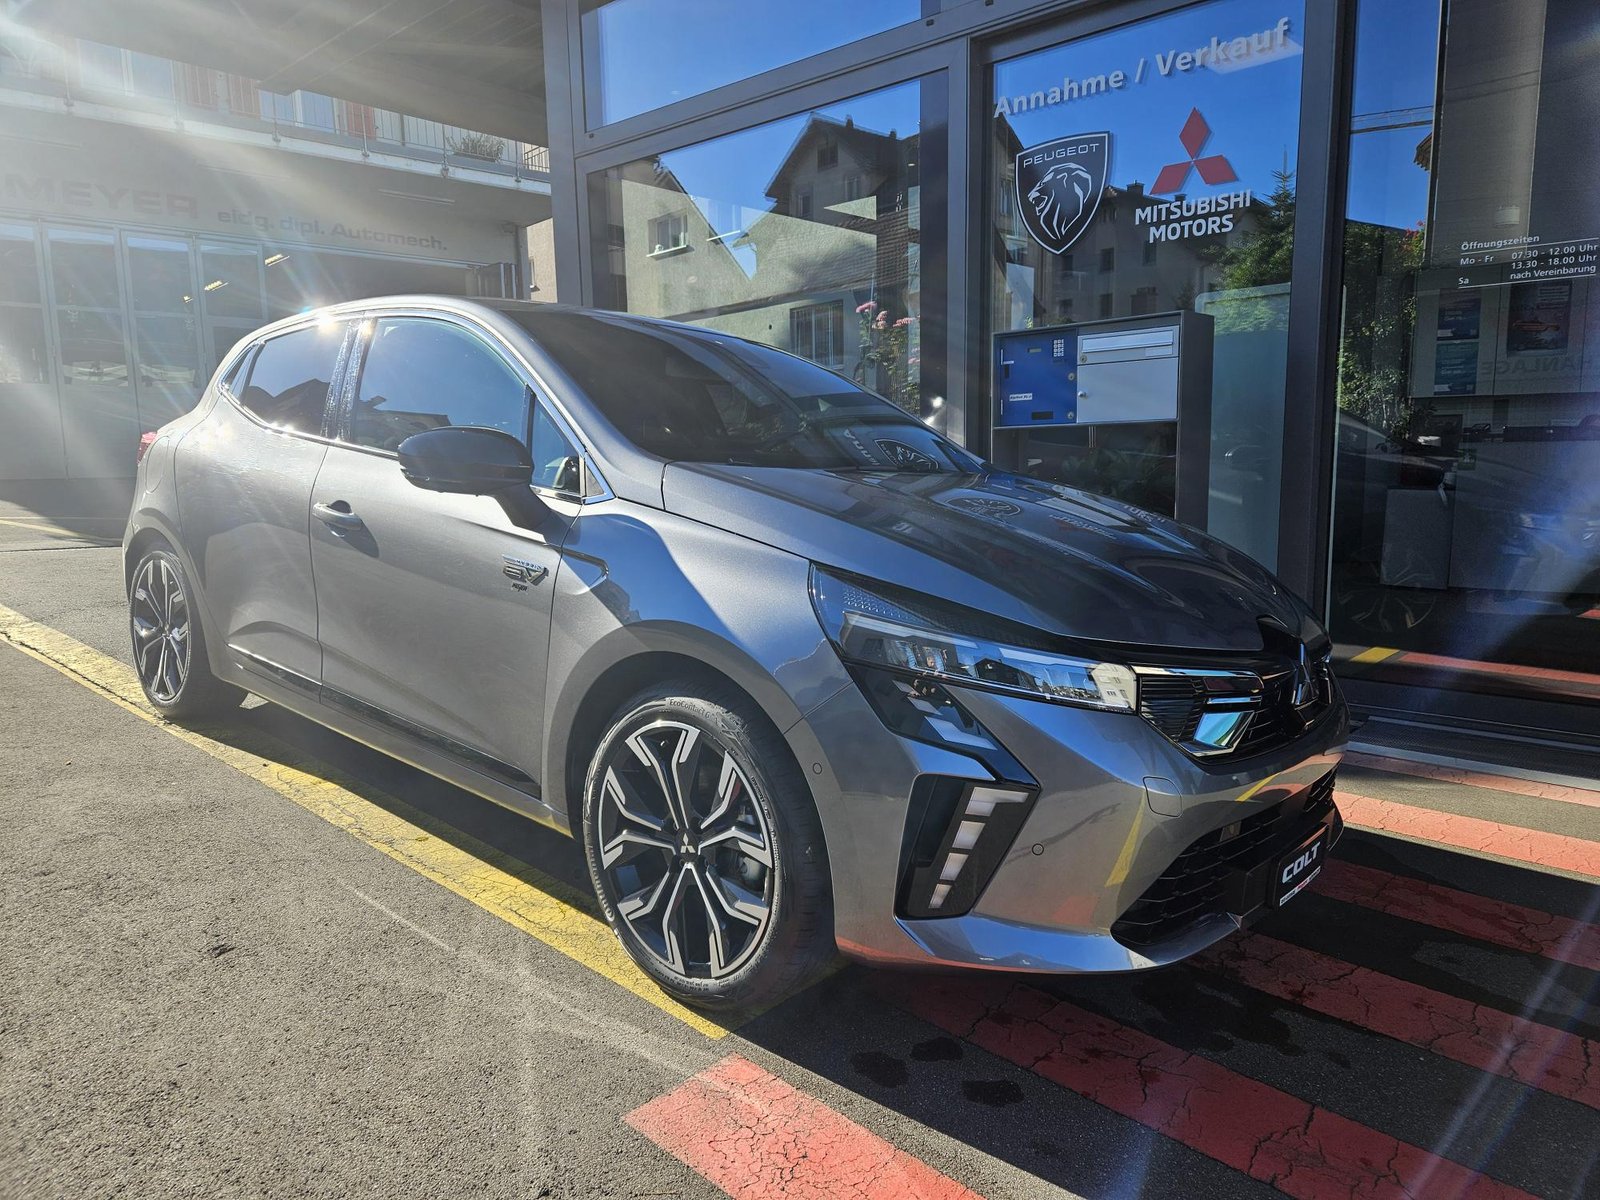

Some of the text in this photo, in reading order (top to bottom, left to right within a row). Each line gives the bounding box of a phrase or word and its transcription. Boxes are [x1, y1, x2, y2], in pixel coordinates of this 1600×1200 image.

[993, 17, 1290, 118] Annahme / Verkauf
[1022, 142, 1100, 169] PEUGEOT
[4, 175, 200, 219] MEYER
[279, 216, 325, 236] dipl.
[331, 222, 448, 251] Automech.
[1134, 188, 1252, 226] MITSUBISHI
[1148, 213, 1235, 244] MOTORS
[1460, 257, 1475, 266] Mo
[1485, 255, 1494, 263] Fr
[1511, 249, 1538, 260] 07.30
[1549, 245, 1576, 256] 12.00
[1579, 243, 1598, 253] Uhr
[1461, 236, 1539, 251] Öffnungszeiten
[1458, 264, 1597, 285] Sa nach Vereinbarung
[1511, 260, 1538, 269] 13.30
[1548, 255, 1575, 266] 18.00
[1578, 254, 1598, 263] Uhr
[1282, 841, 1320, 884] COLT
